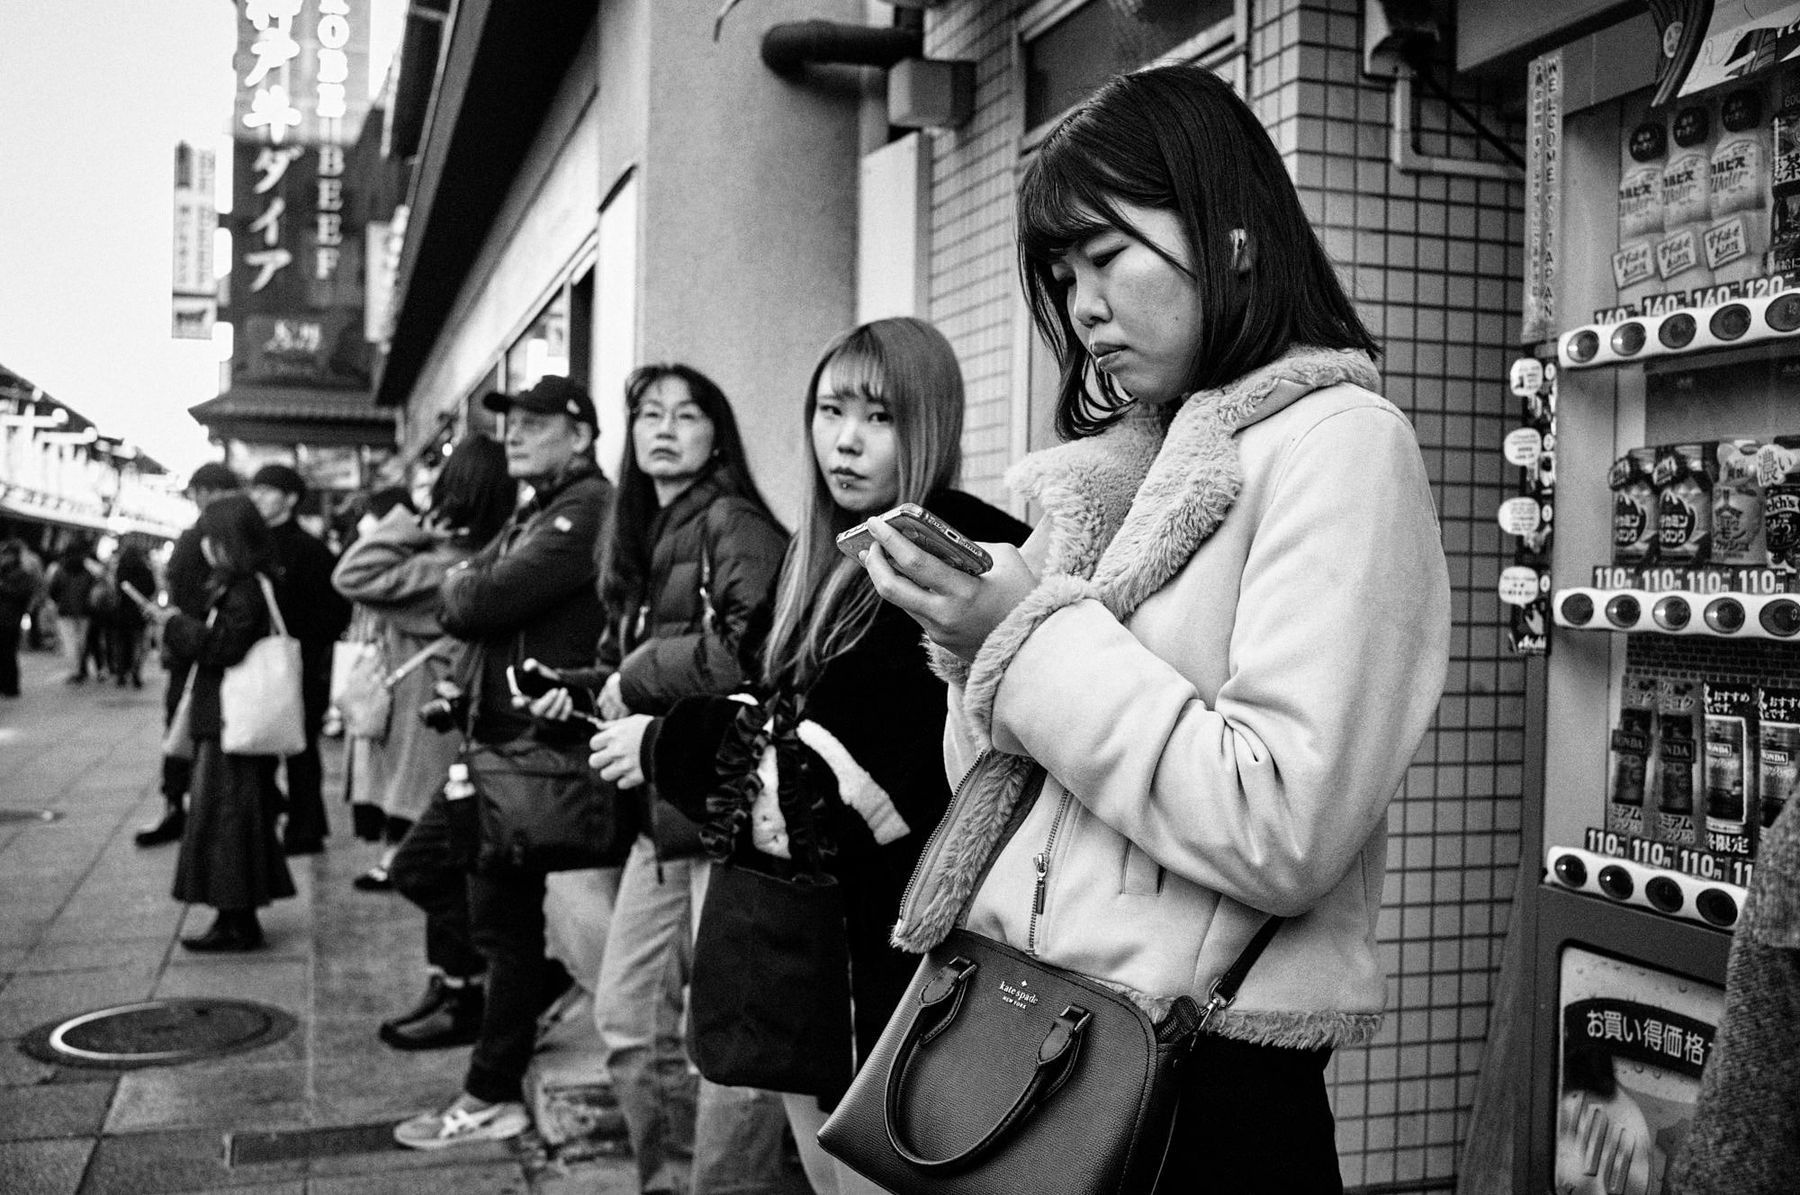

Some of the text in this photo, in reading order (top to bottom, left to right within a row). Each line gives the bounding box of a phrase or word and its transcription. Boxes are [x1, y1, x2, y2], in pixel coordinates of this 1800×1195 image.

[1546, 62, 1558, 183] WELCOME
[1769, 696, 1800, 709] おすす
[999, 980, 1039, 1004] kate spade
[1002, 995, 1027, 1010] NEW YORK
[1587, 1009, 1705, 1067] お買い得価格
